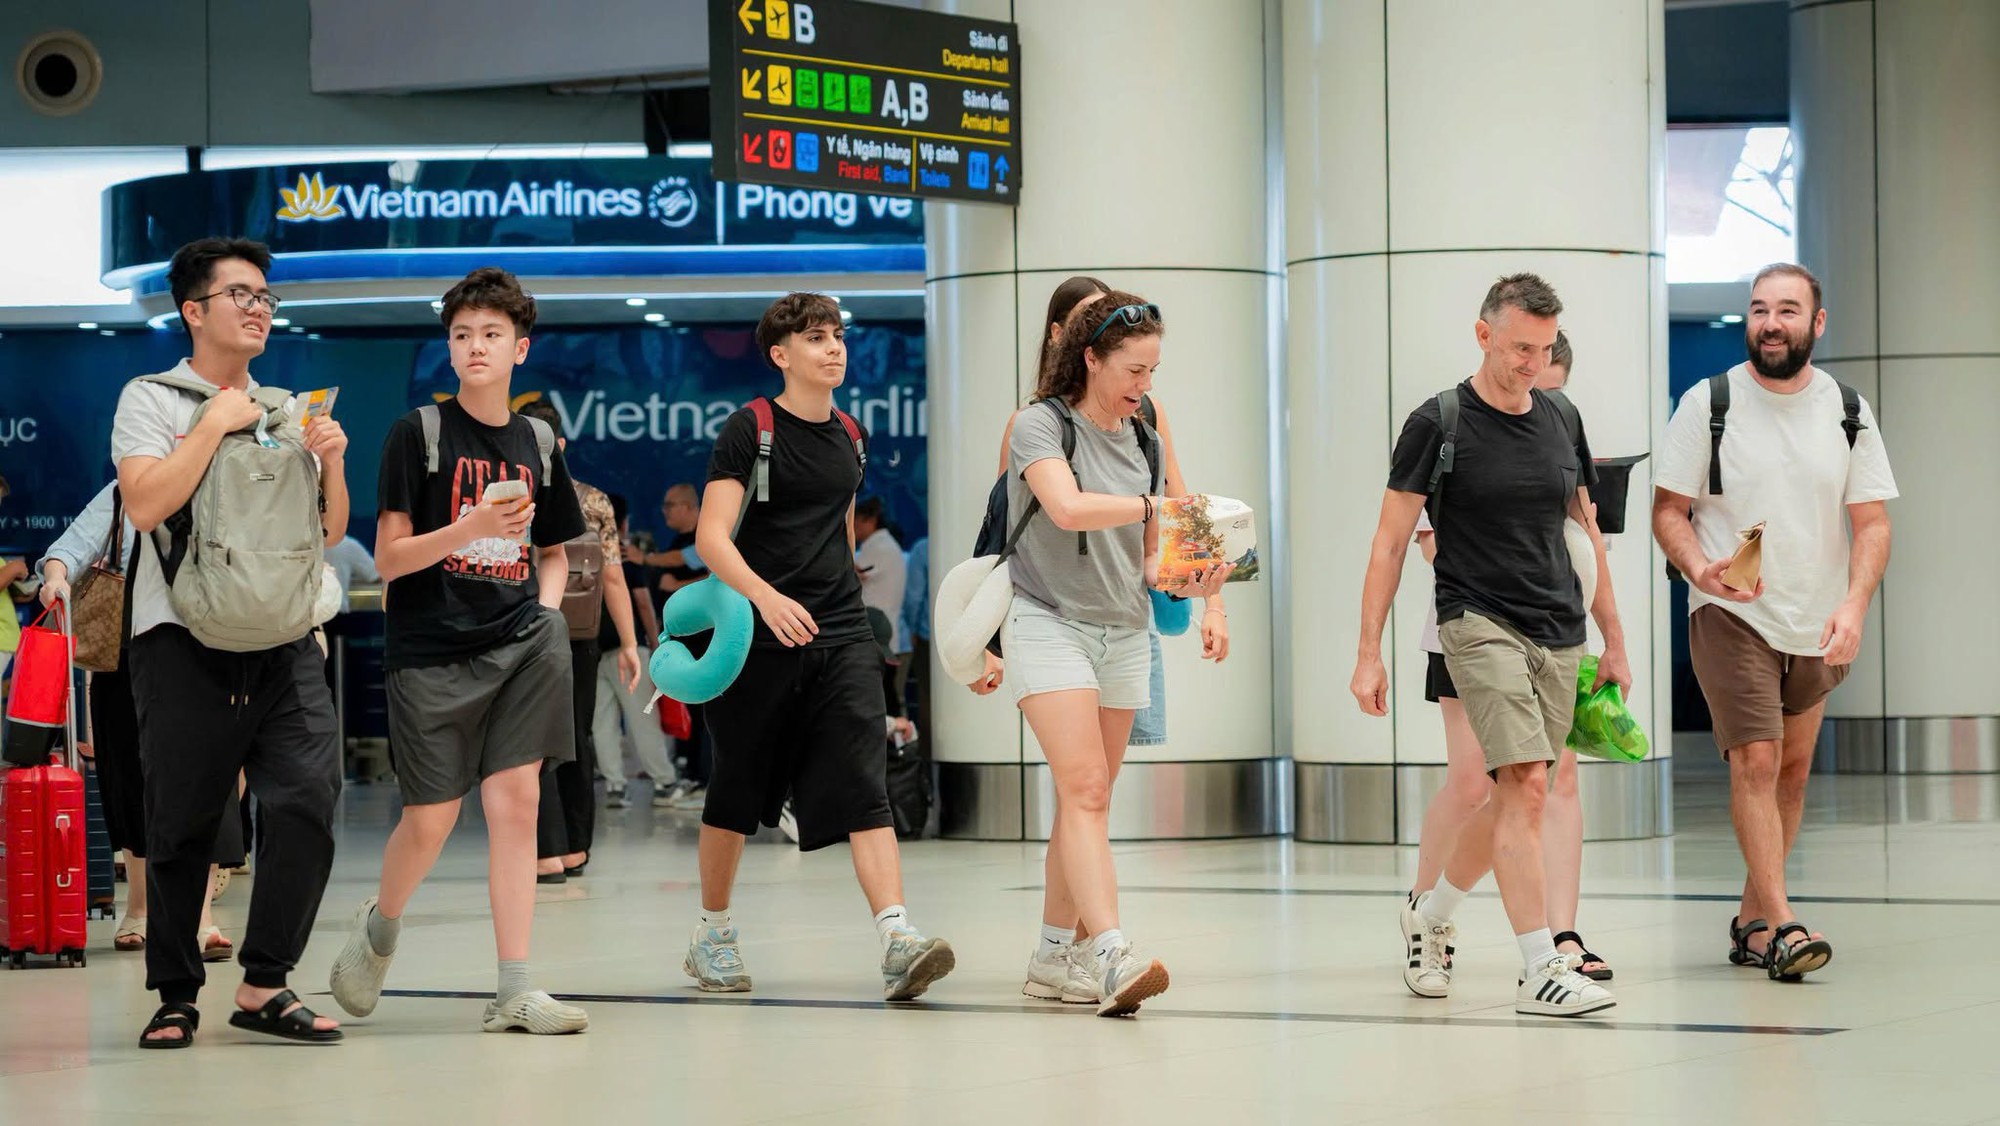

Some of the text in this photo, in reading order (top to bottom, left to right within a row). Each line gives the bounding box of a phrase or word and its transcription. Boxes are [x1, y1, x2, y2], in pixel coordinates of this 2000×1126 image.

[794, 3, 816, 44] B
[942, 48, 1009, 74] Departure hall
[881, 79, 929, 127] A,B
[961, 112, 1010, 134] Arrival hall
[826, 136, 836, 154] Y
[853, 139, 882, 161] Ngân
[884, 142, 911, 166] hàng
[920, 143, 959, 165] Vệ sinh
[838, 161, 861, 179] First
[884, 165, 910, 184] Bank
[343, 184, 498, 219] Vietnam
[499, 180, 643, 217] Airlines
[549, 384, 927, 441] Vietna irli
[26, 515, 55, 530] 1900
[443, 553, 530, 581] SECOND
